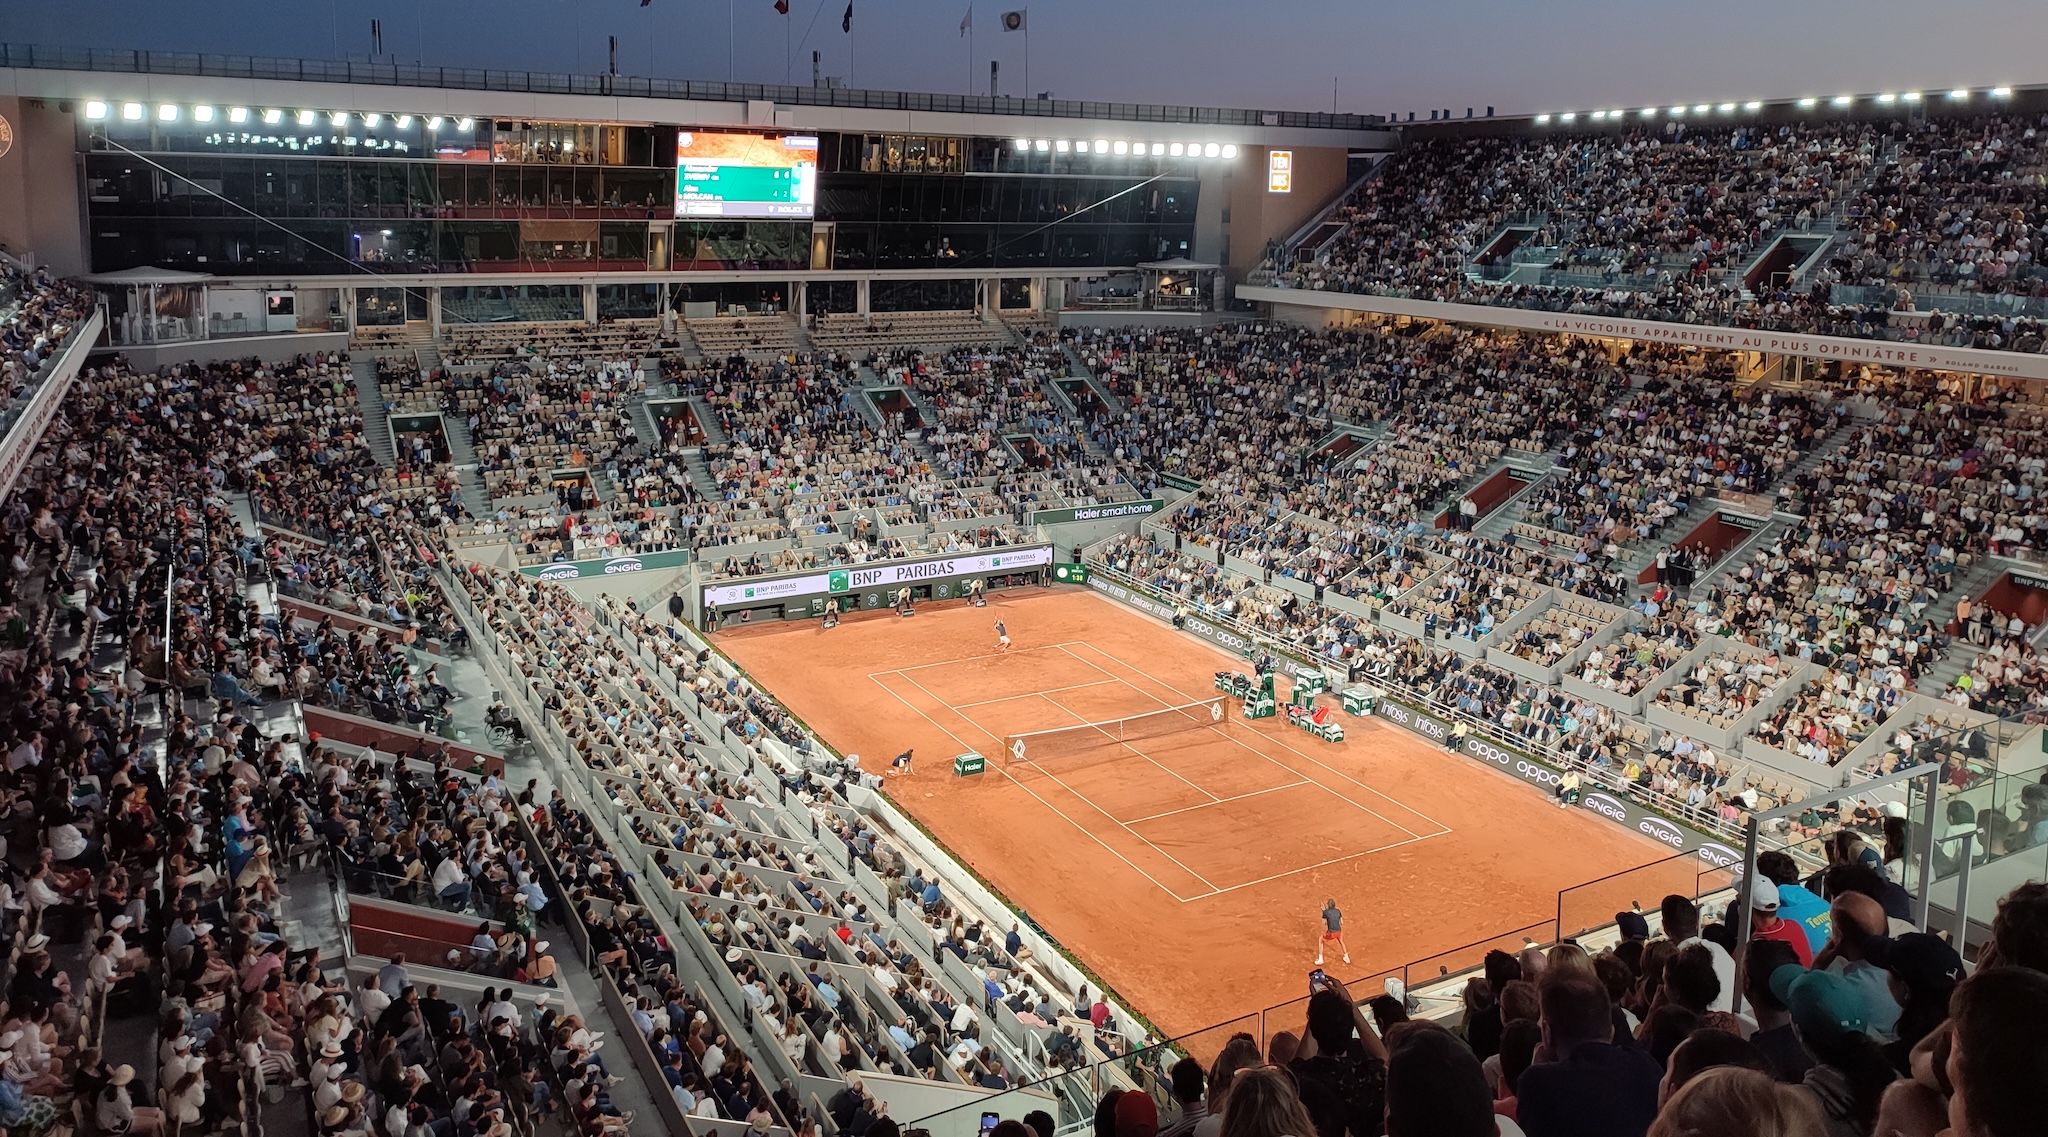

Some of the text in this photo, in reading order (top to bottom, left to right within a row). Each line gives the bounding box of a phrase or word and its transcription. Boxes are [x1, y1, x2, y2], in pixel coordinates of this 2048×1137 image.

[1555, 320, 1568, 328] LA
[1575, 322, 1636, 334] VICTOIRE
[1644, 328, 1734, 344] APPARTIENT
[1742, 338, 1761, 346] AU
[1771, 340, 1808, 351] PLUS
[1074, 504, 1153, 520] Haier smart home
[852, 562, 954, 586] BNP PARIBAS
[1087, 574, 1108, 591] Emirates
[2014, 576, 2033, 586] BNP
[1130, 594, 1153, 610] Emirates
[1188, 618, 1213, 635] oppo
[1216, 632, 1243, 648] oppo
[1381, 701, 1409, 724] Infosys
[1414, 715, 1444, 738] Infosys
[1468, 740, 1510, 764] oppo
[1516, 760, 1561, 787] oppo
